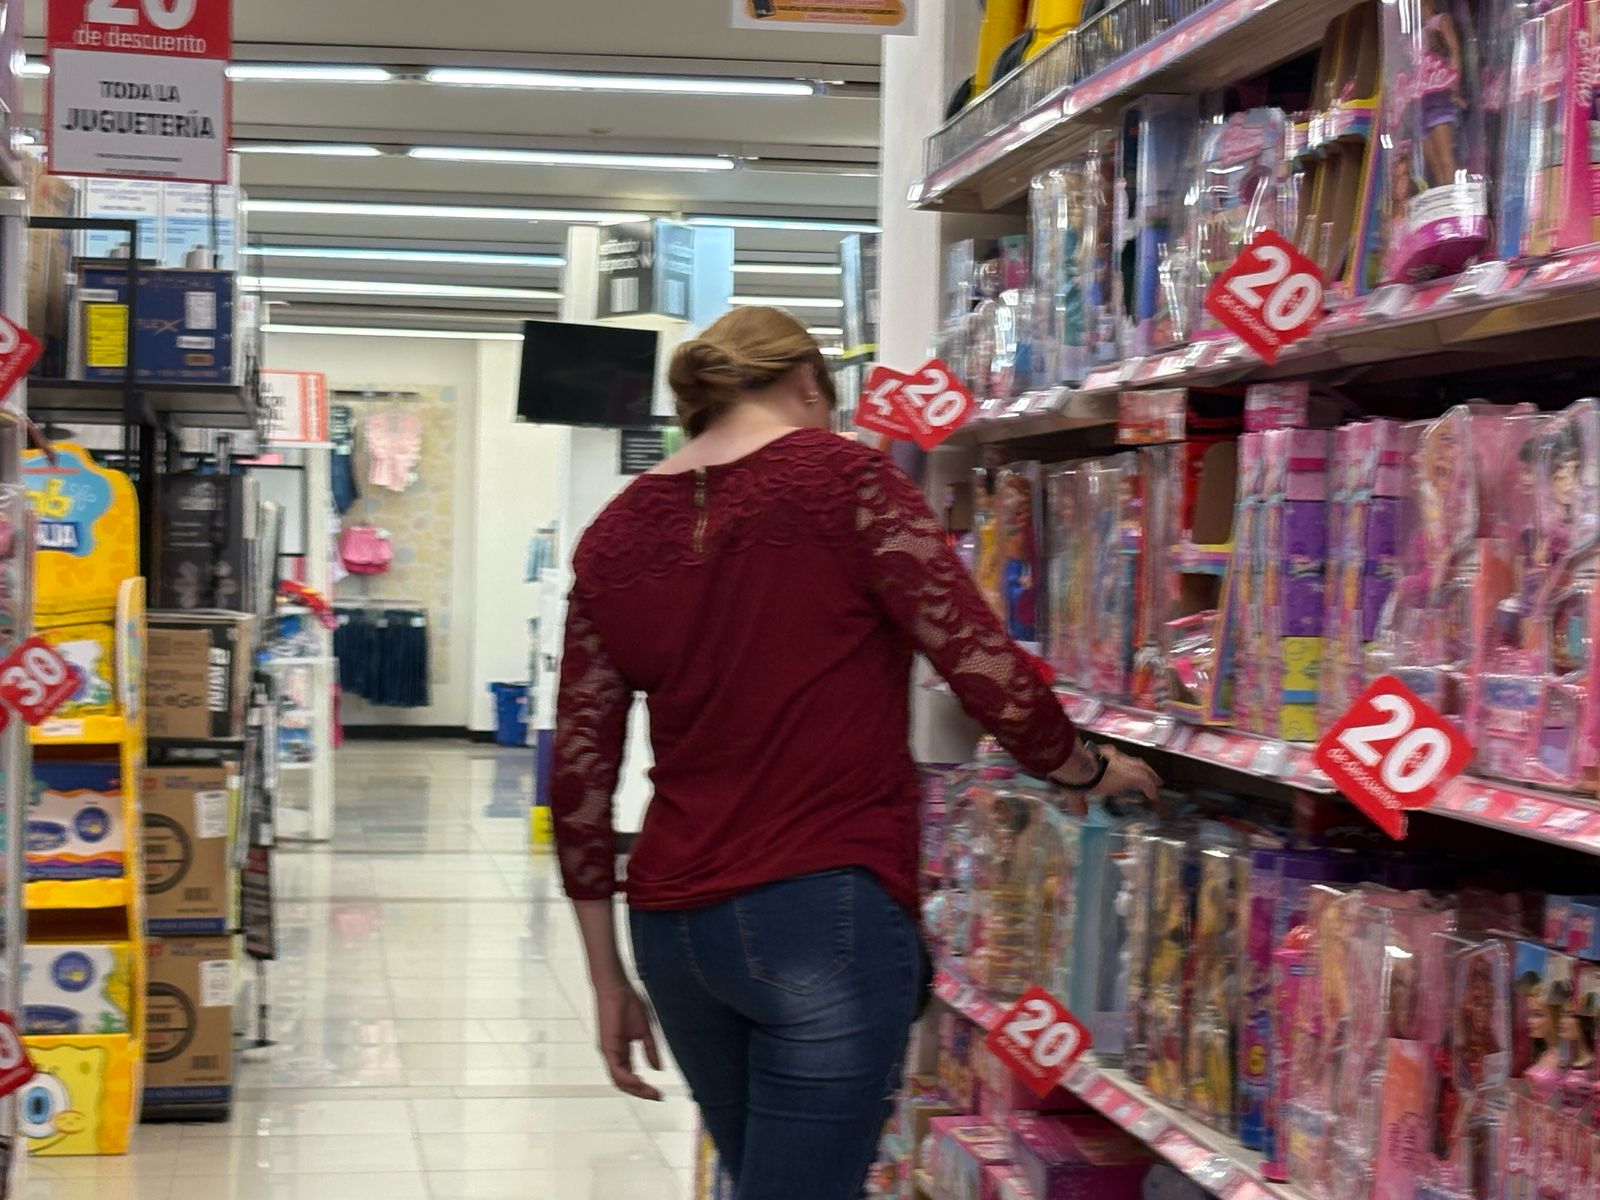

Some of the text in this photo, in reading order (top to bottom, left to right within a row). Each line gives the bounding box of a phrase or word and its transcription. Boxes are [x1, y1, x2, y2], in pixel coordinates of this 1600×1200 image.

[73, 24, 207, 53] de descuento
[98, 80, 181, 103] TODA LA
[61, 108, 216, 139] JUGUETERÍA
[1224, 246, 1322, 331] 20
[902, 368, 966, 427] 20
[0, 647, 67, 706] 30
[1336, 694, 1451, 793] 20
[1003, 998, 1080, 1067] 20
